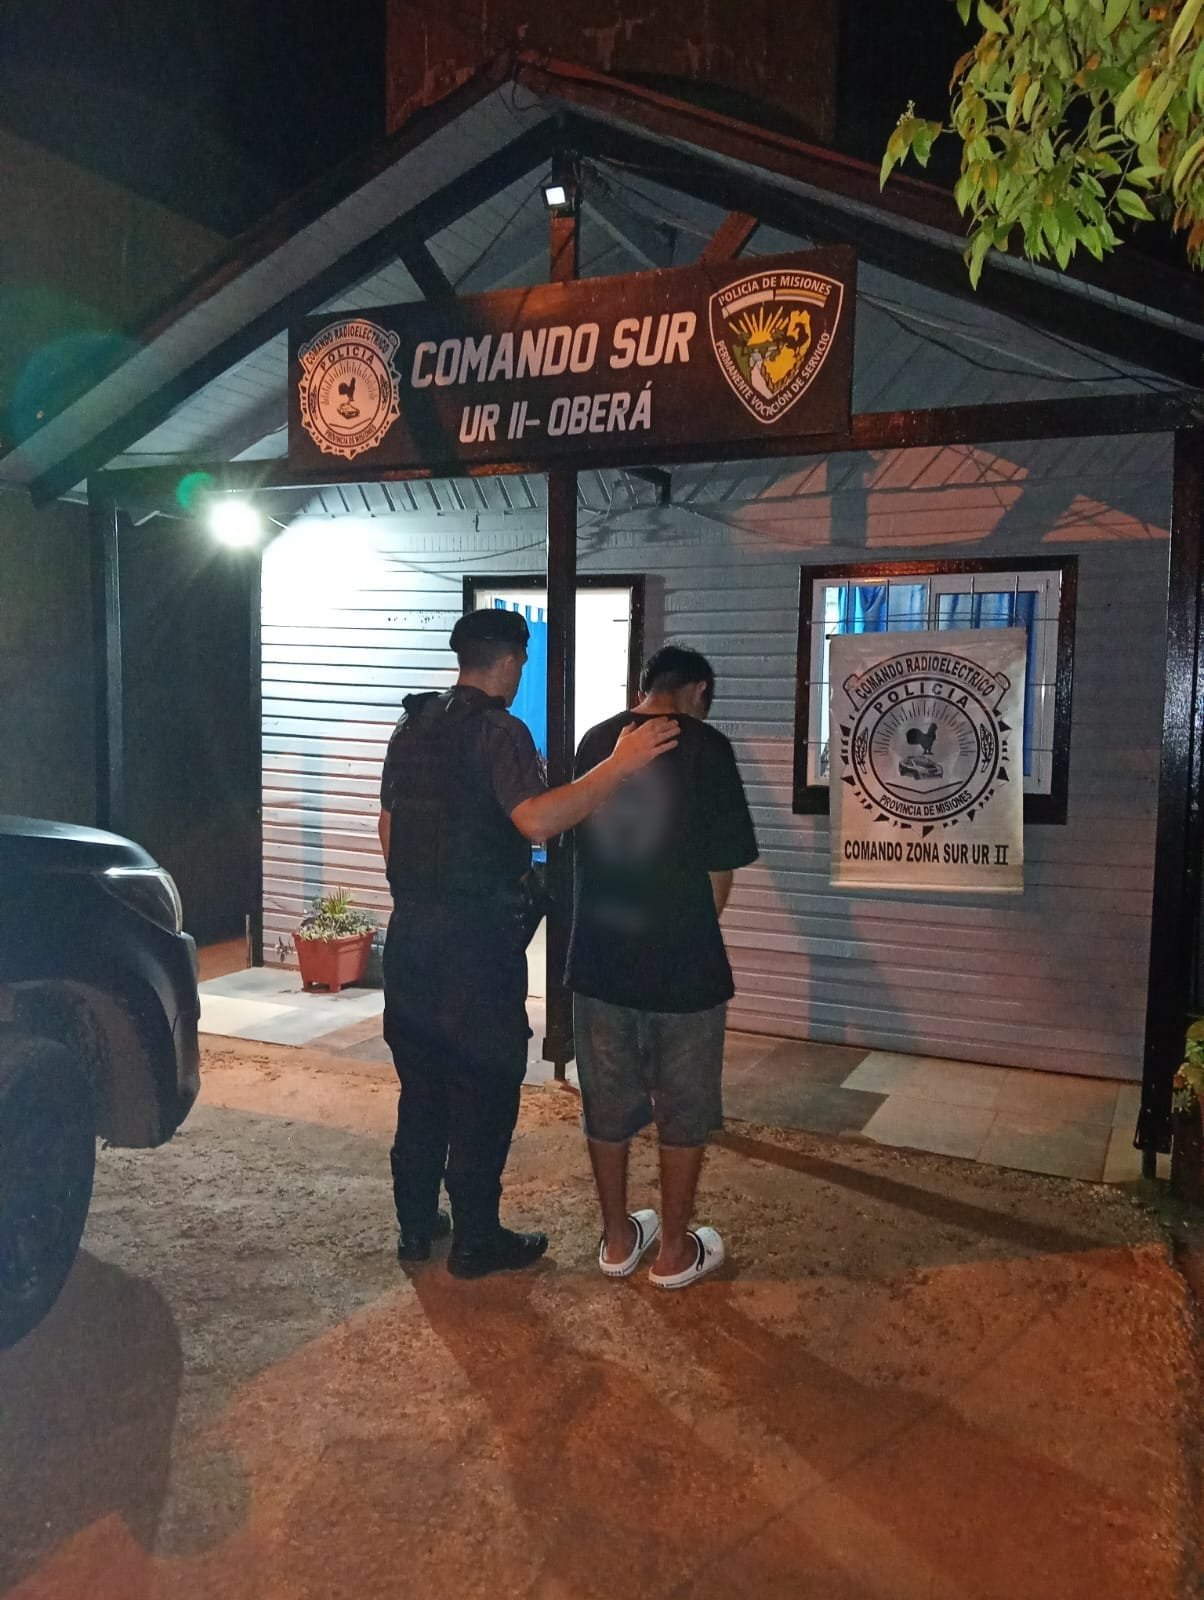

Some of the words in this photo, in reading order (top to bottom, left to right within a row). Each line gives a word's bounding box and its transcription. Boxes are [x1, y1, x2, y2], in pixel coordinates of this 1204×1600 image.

[763, 277, 777, 288] DE
[780, 275, 832, 296] MISIONES
[306, 333, 333, 365] COMANDO
[320, 346, 375, 371] POLICIA
[411, 322, 600, 388] COMANDO
[609, 311, 697, 369] SUR
[716, 339, 753, 400] PERMANENTE
[792, 380, 804, 392] DE
[801, 332, 831, 378] SERVICIO
[459, 404, 500, 443] UR
[547, 381, 652, 437] OBERÁ
[855, 661, 904, 700] COMANDO
[905, 655, 996, 697] RADIOELECTRICO
[873, 682, 970, 715] POLICIA
[879, 794, 923, 817] PROVINCIA
[923, 805, 935, 816] DE
[936, 790, 974, 815] MISIONES
[844, 839, 903, 862] COMANDO
[906, 842, 940, 863] ZONA
[943, 843, 969, 865] SUR
[972, 844, 990, 866] UR
[993, 844, 1009, 866] II
